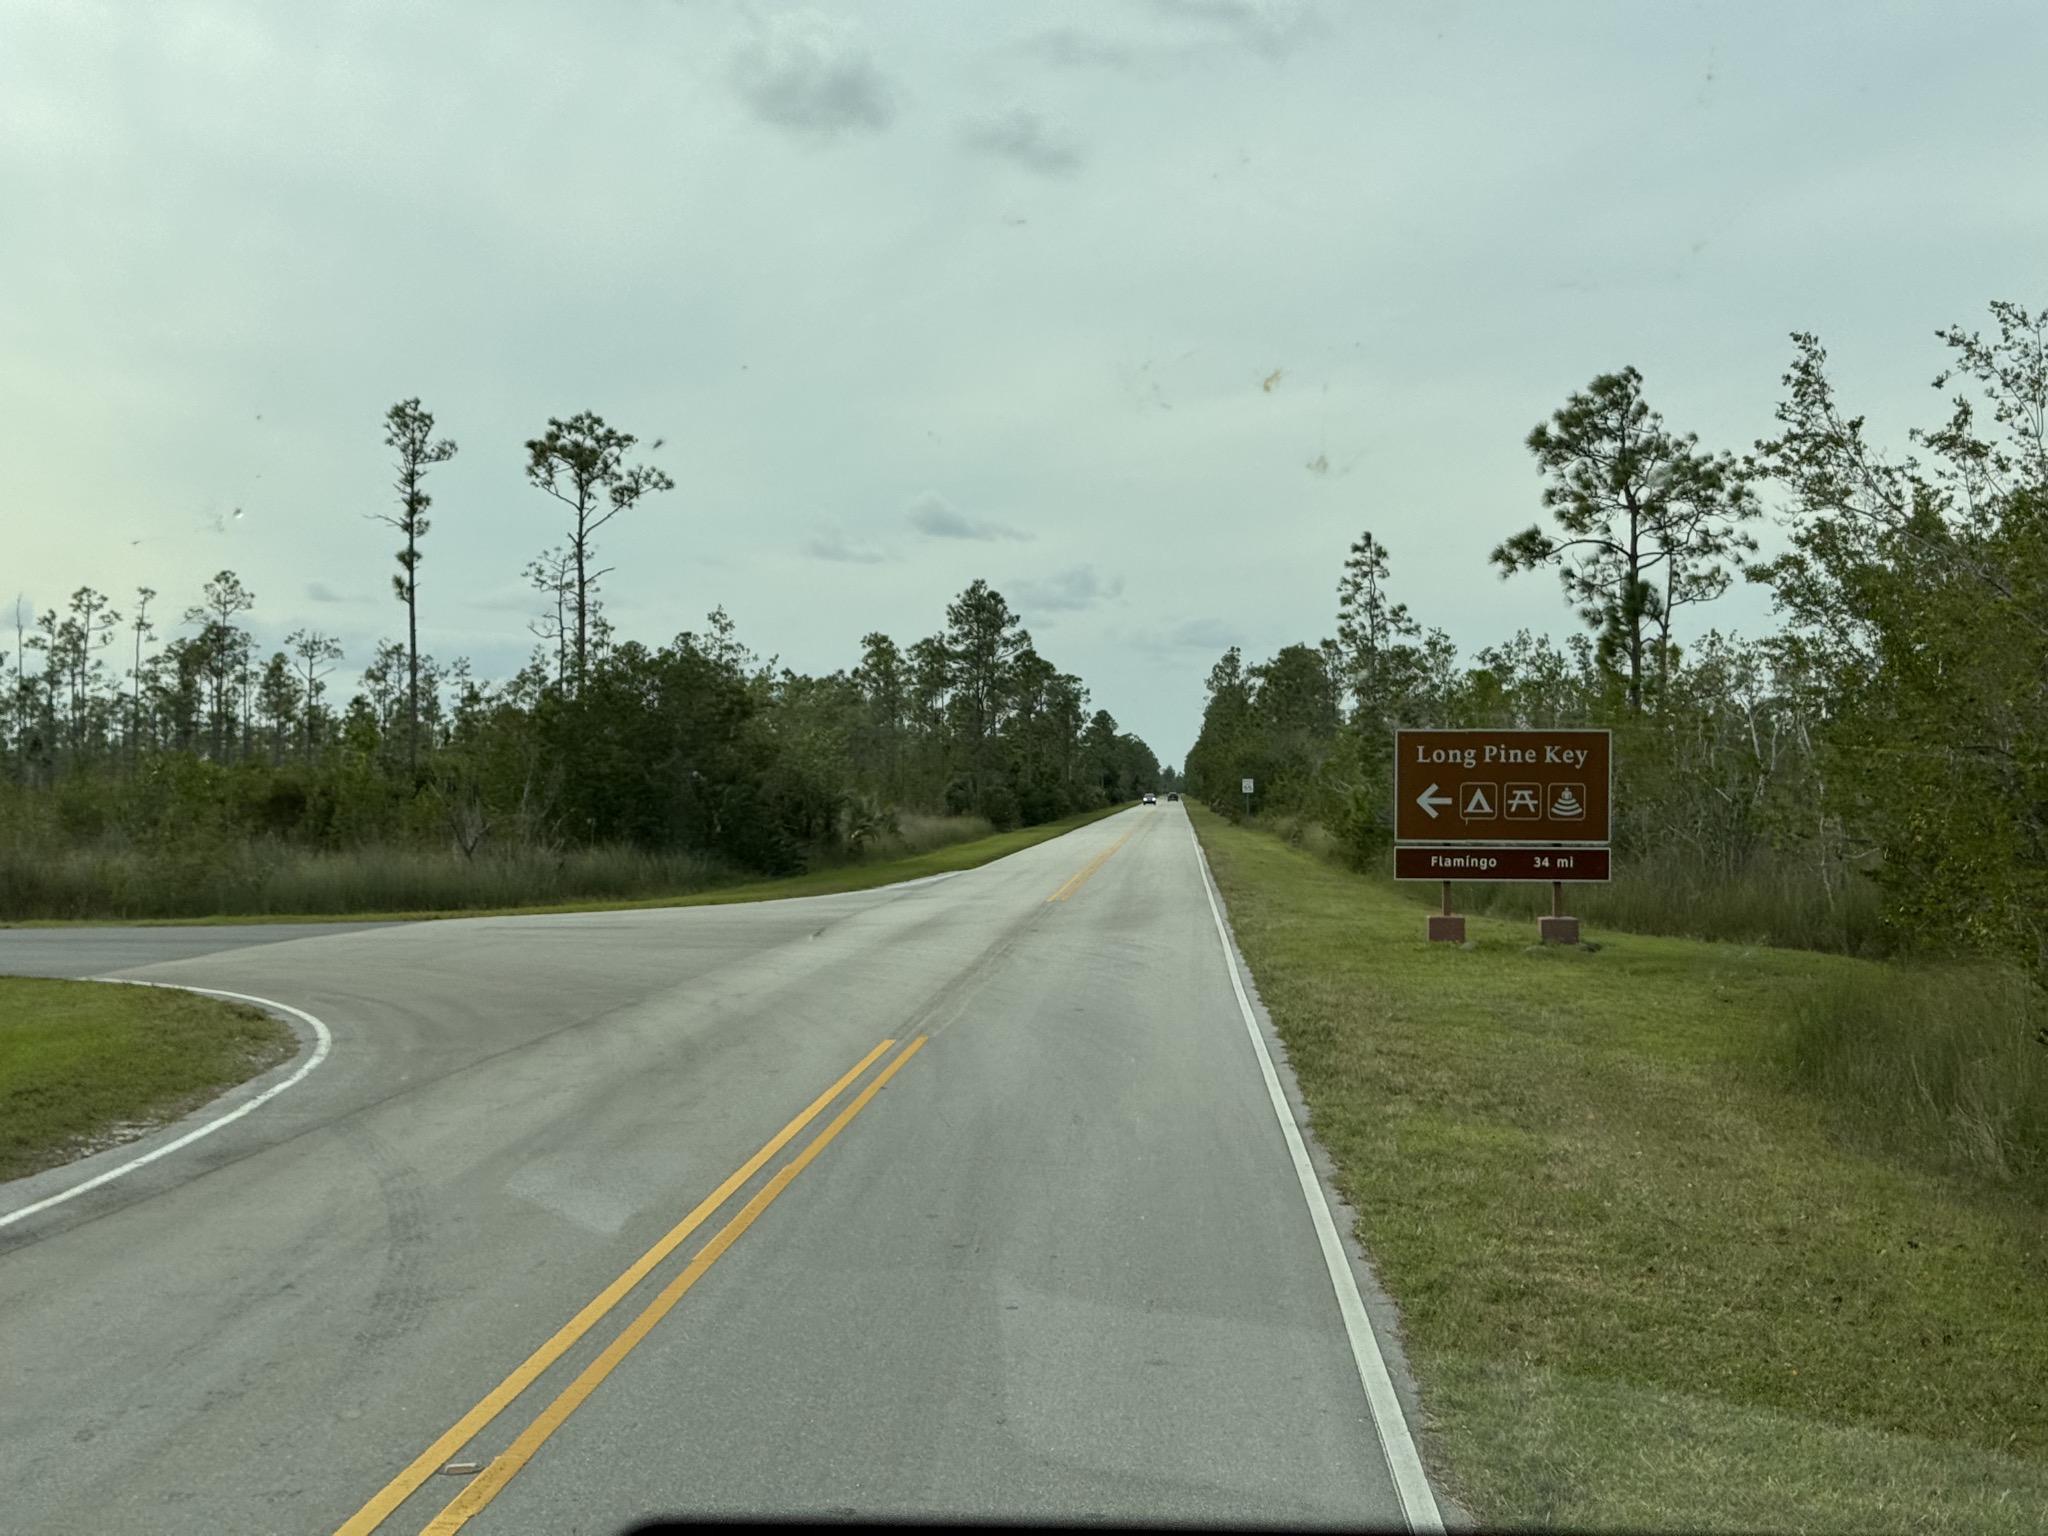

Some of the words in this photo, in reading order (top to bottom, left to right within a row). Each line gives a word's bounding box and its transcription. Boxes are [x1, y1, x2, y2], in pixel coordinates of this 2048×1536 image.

[1416, 745, 1477, 769] Long
[1483, 744, 1537, 763] Pine
[1544, 745, 1588, 769] Key
[1431, 855, 1497, 871] Flamingo
[1533, 857, 1550, 868] 34
[1557, 856, 1574, 868] mi
